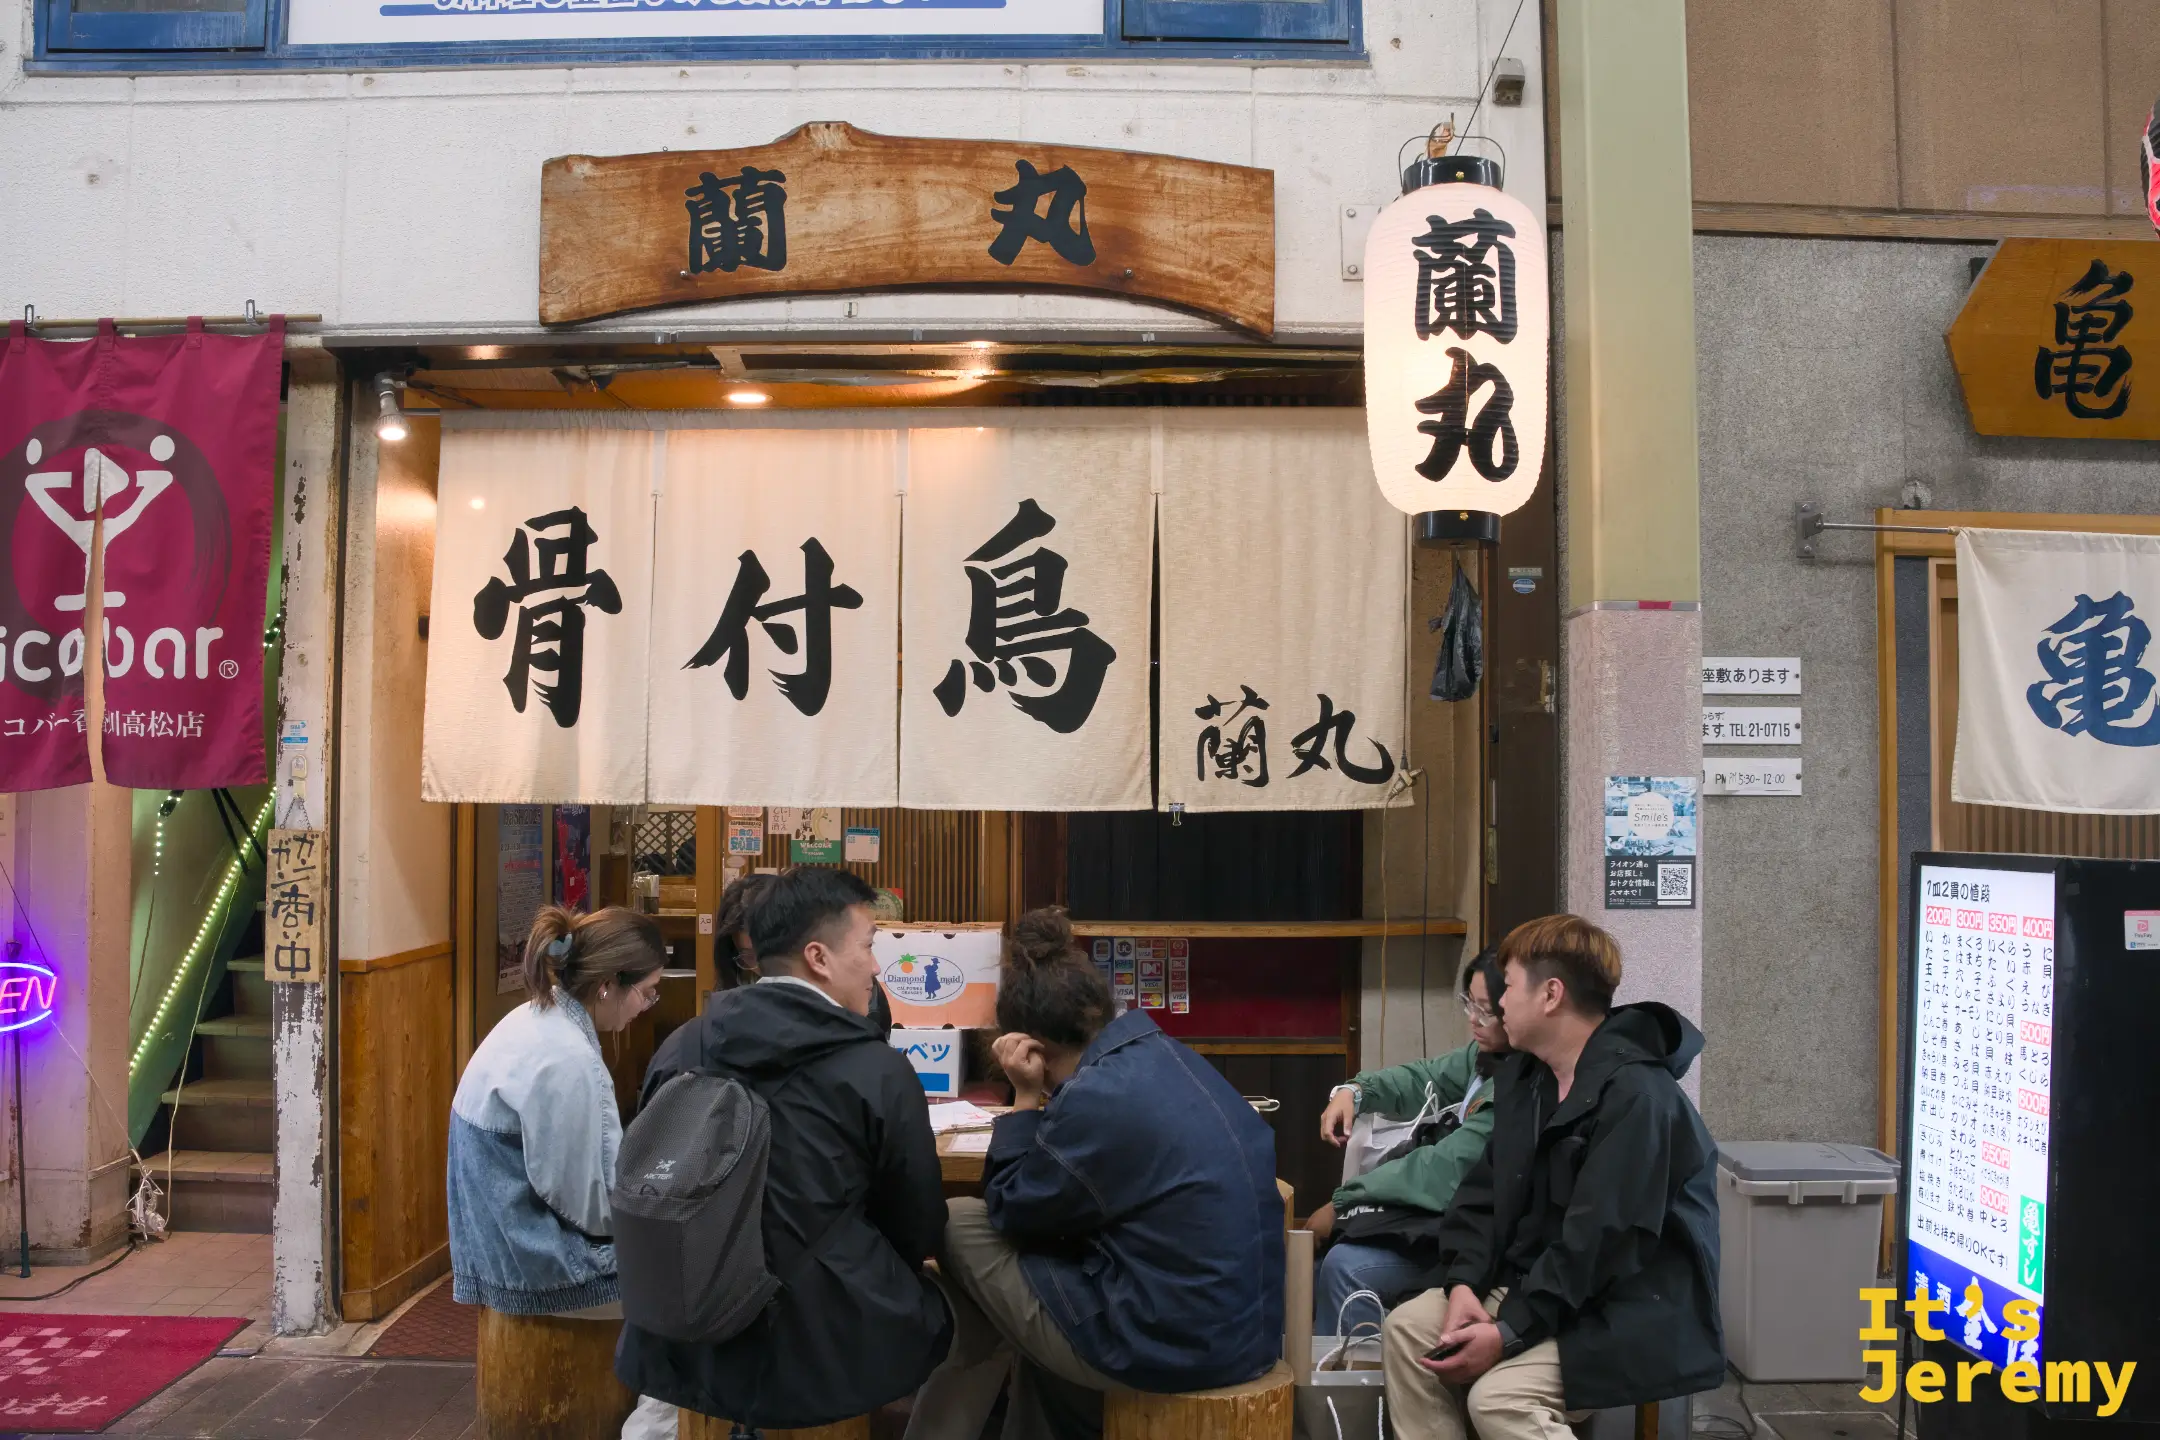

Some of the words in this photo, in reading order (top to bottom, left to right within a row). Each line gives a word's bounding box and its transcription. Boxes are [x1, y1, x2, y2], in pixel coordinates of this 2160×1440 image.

[685, 159, 1096, 273] 蘭丸
[1412, 208, 1519, 482] 蘭丸
[2035, 258, 2134, 420] 亀
[474, 498, 1117, 733] 骨付鳥
[1195, 684, 1396, 787] 蘭丸
[1729, 723, 1746, 737] TEL
[1748, 722, 1791, 737] 21-0715
[1634, 812, 1669, 822] Smile's
[1927, 908, 1951, 925] 200円
[1957, 911, 1983, 928] 300円
[1989, 915, 2016, 933] 350円
[2024, 919, 2052, 938] 400円
[1925, 947, 1950, 962] たこ
[1988, 938, 2016, 955] いくら
[2022, 943, 2052, 960] うに
[1956, 951, 1982, 967] はまち
[1987, 956, 2016, 973] たい
[887, 974, 925, 984] Diamond
[1925, 962, 1949, 979] 玉子
[1955, 967, 1982, 985] 穴子
[1116, 988, 1134, 996] VISA
[2021, 1023, 2049, 1044] 500円
[2019, 1067, 2048, 1087] くじら
[2019, 1090, 2048, 1114] 600円
[1982, 1143, 2010, 1168] 650円
[1981, 1186, 2008, 1213] 900円
